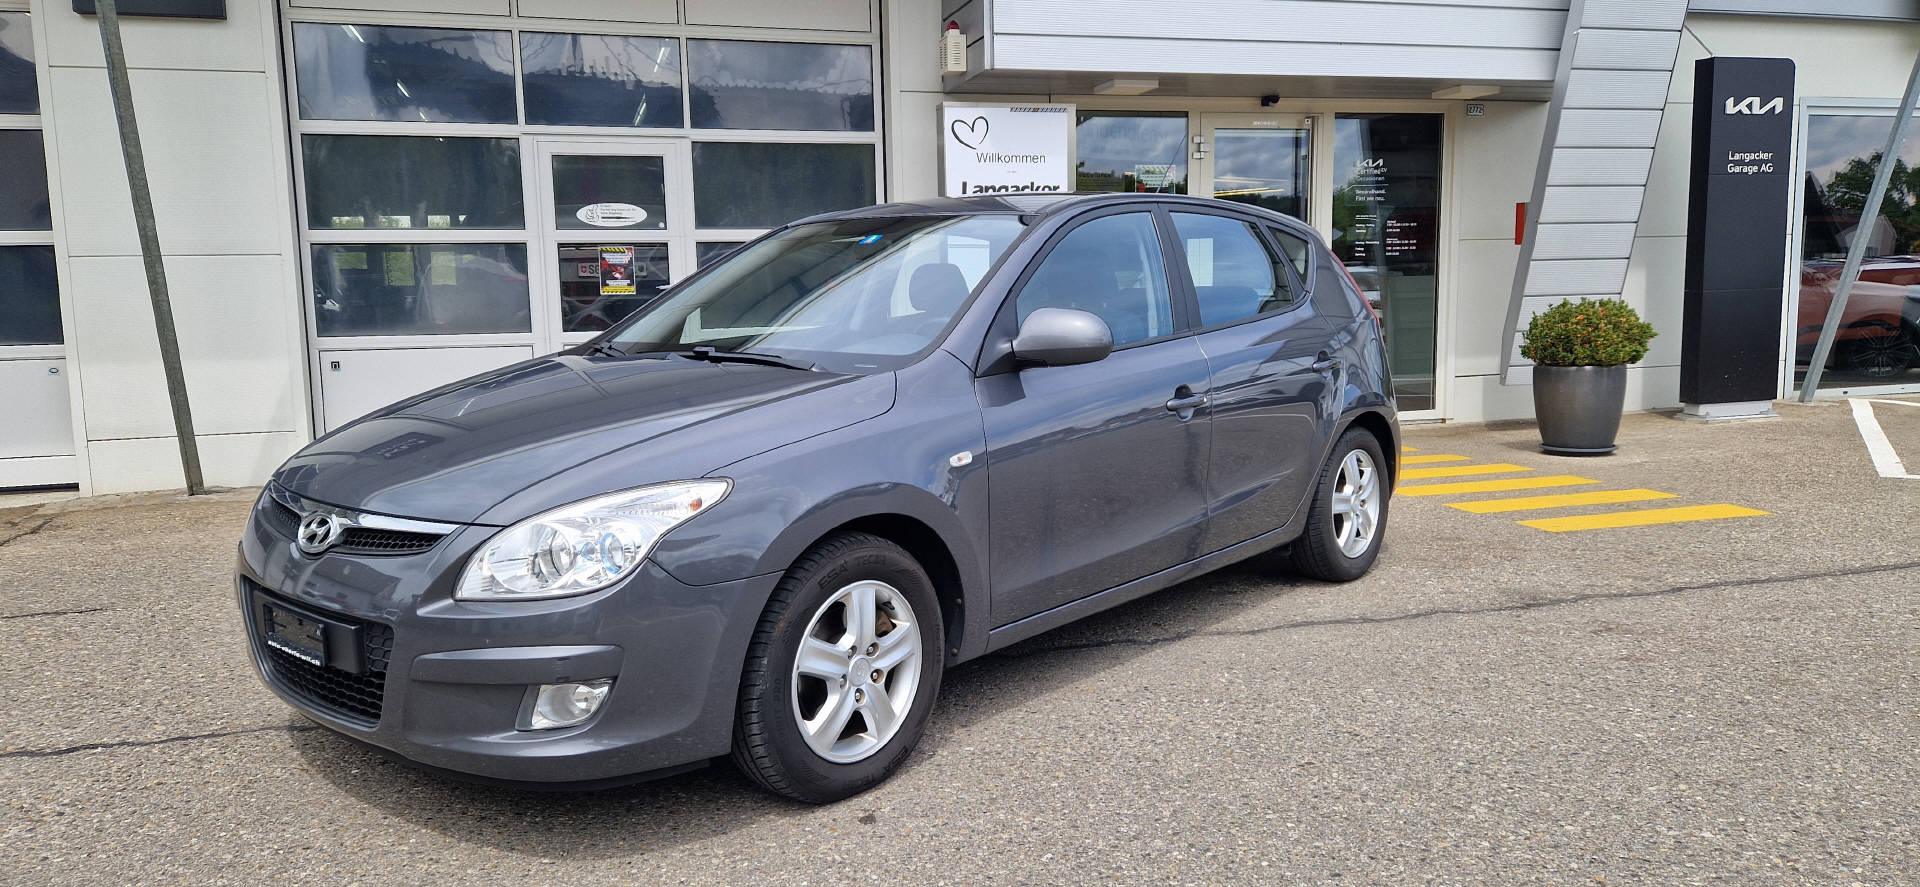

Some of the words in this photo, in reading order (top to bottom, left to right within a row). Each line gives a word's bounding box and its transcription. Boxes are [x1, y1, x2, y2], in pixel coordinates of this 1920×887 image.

[1725, 96, 1784, 115] KIA
[976, 152, 1046, 164] Willkommen
[1728, 151, 1773, 162] Langacker
[1727, 163, 1759, 175] Garage
[1760, 163, 1774, 173] AG
